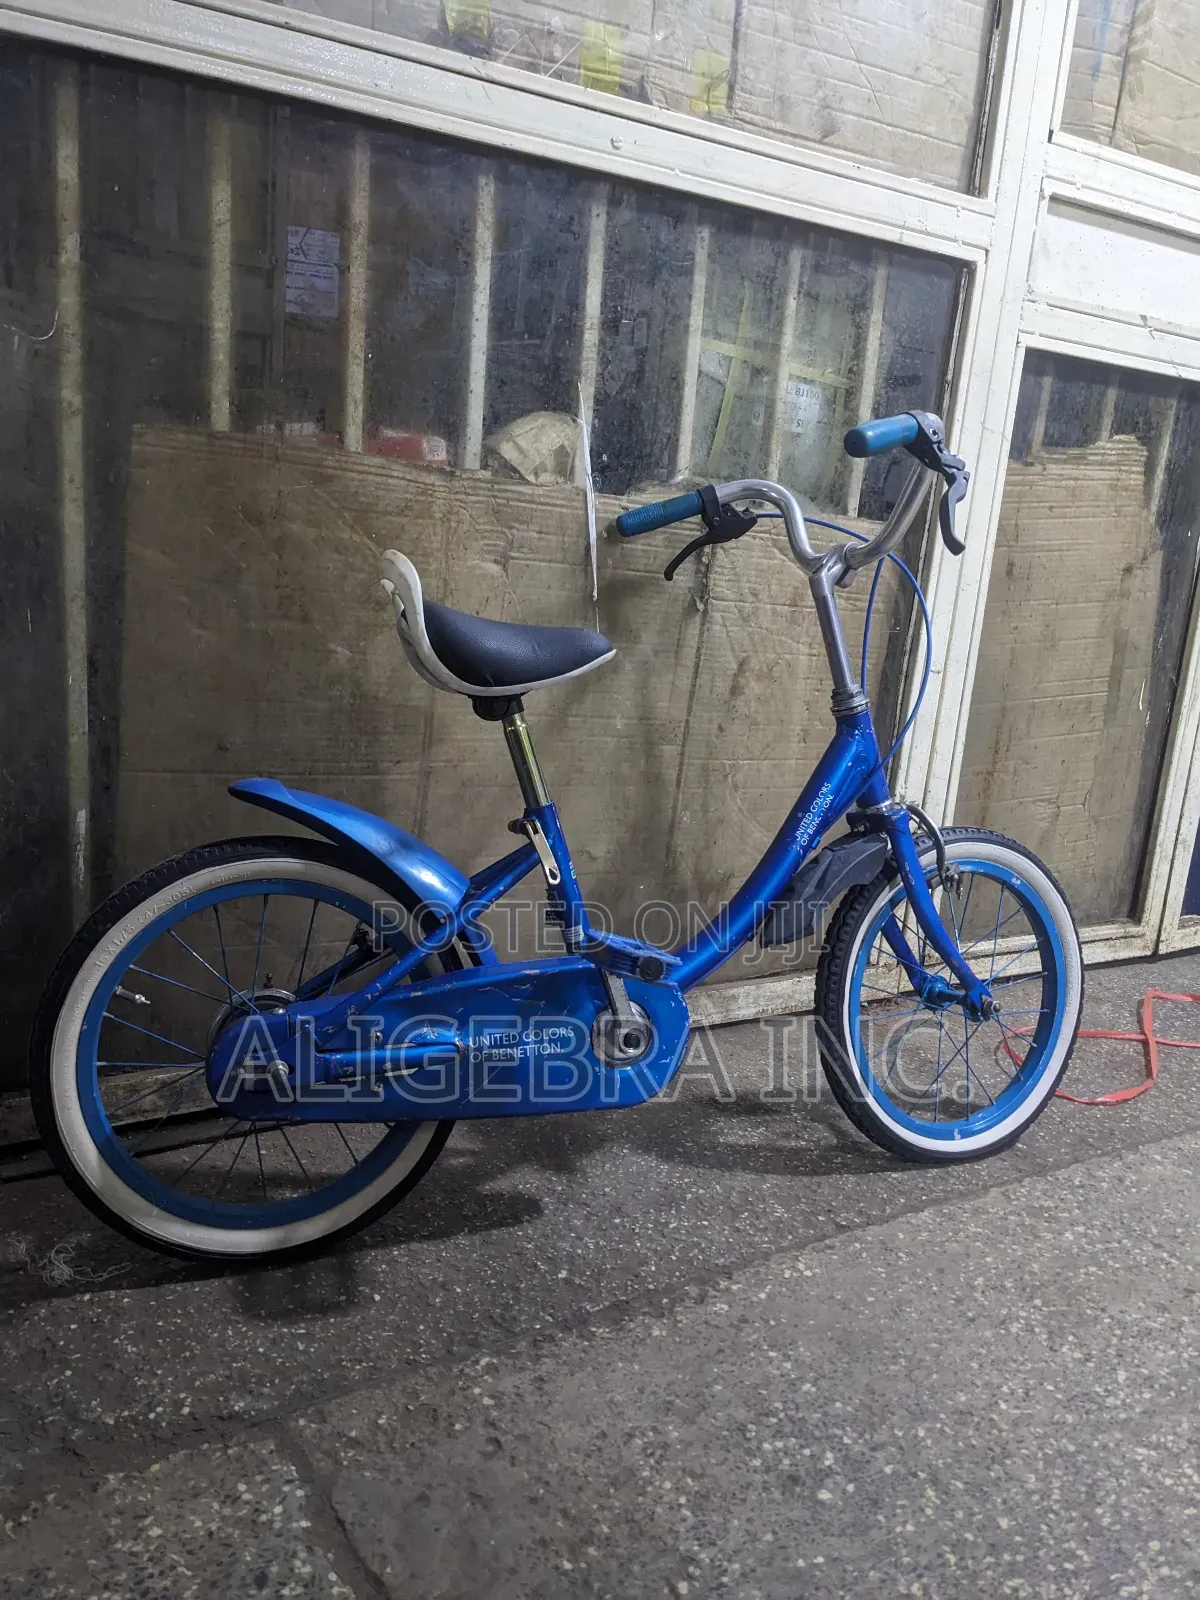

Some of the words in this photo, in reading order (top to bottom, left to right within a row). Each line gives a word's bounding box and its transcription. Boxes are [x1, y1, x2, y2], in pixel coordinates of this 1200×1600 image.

[794, 812, 813, 841] UNITED
[810, 782, 832, 813] COLORS
[801, 833, 810, 846] OF
[469, 1032, 520, 1048] UNITED
[522, 1026, 574, 1042] COLORS
[470, 1051, 489, 1063] OF
[492, 1042, 564, 1061] BENETTON.
